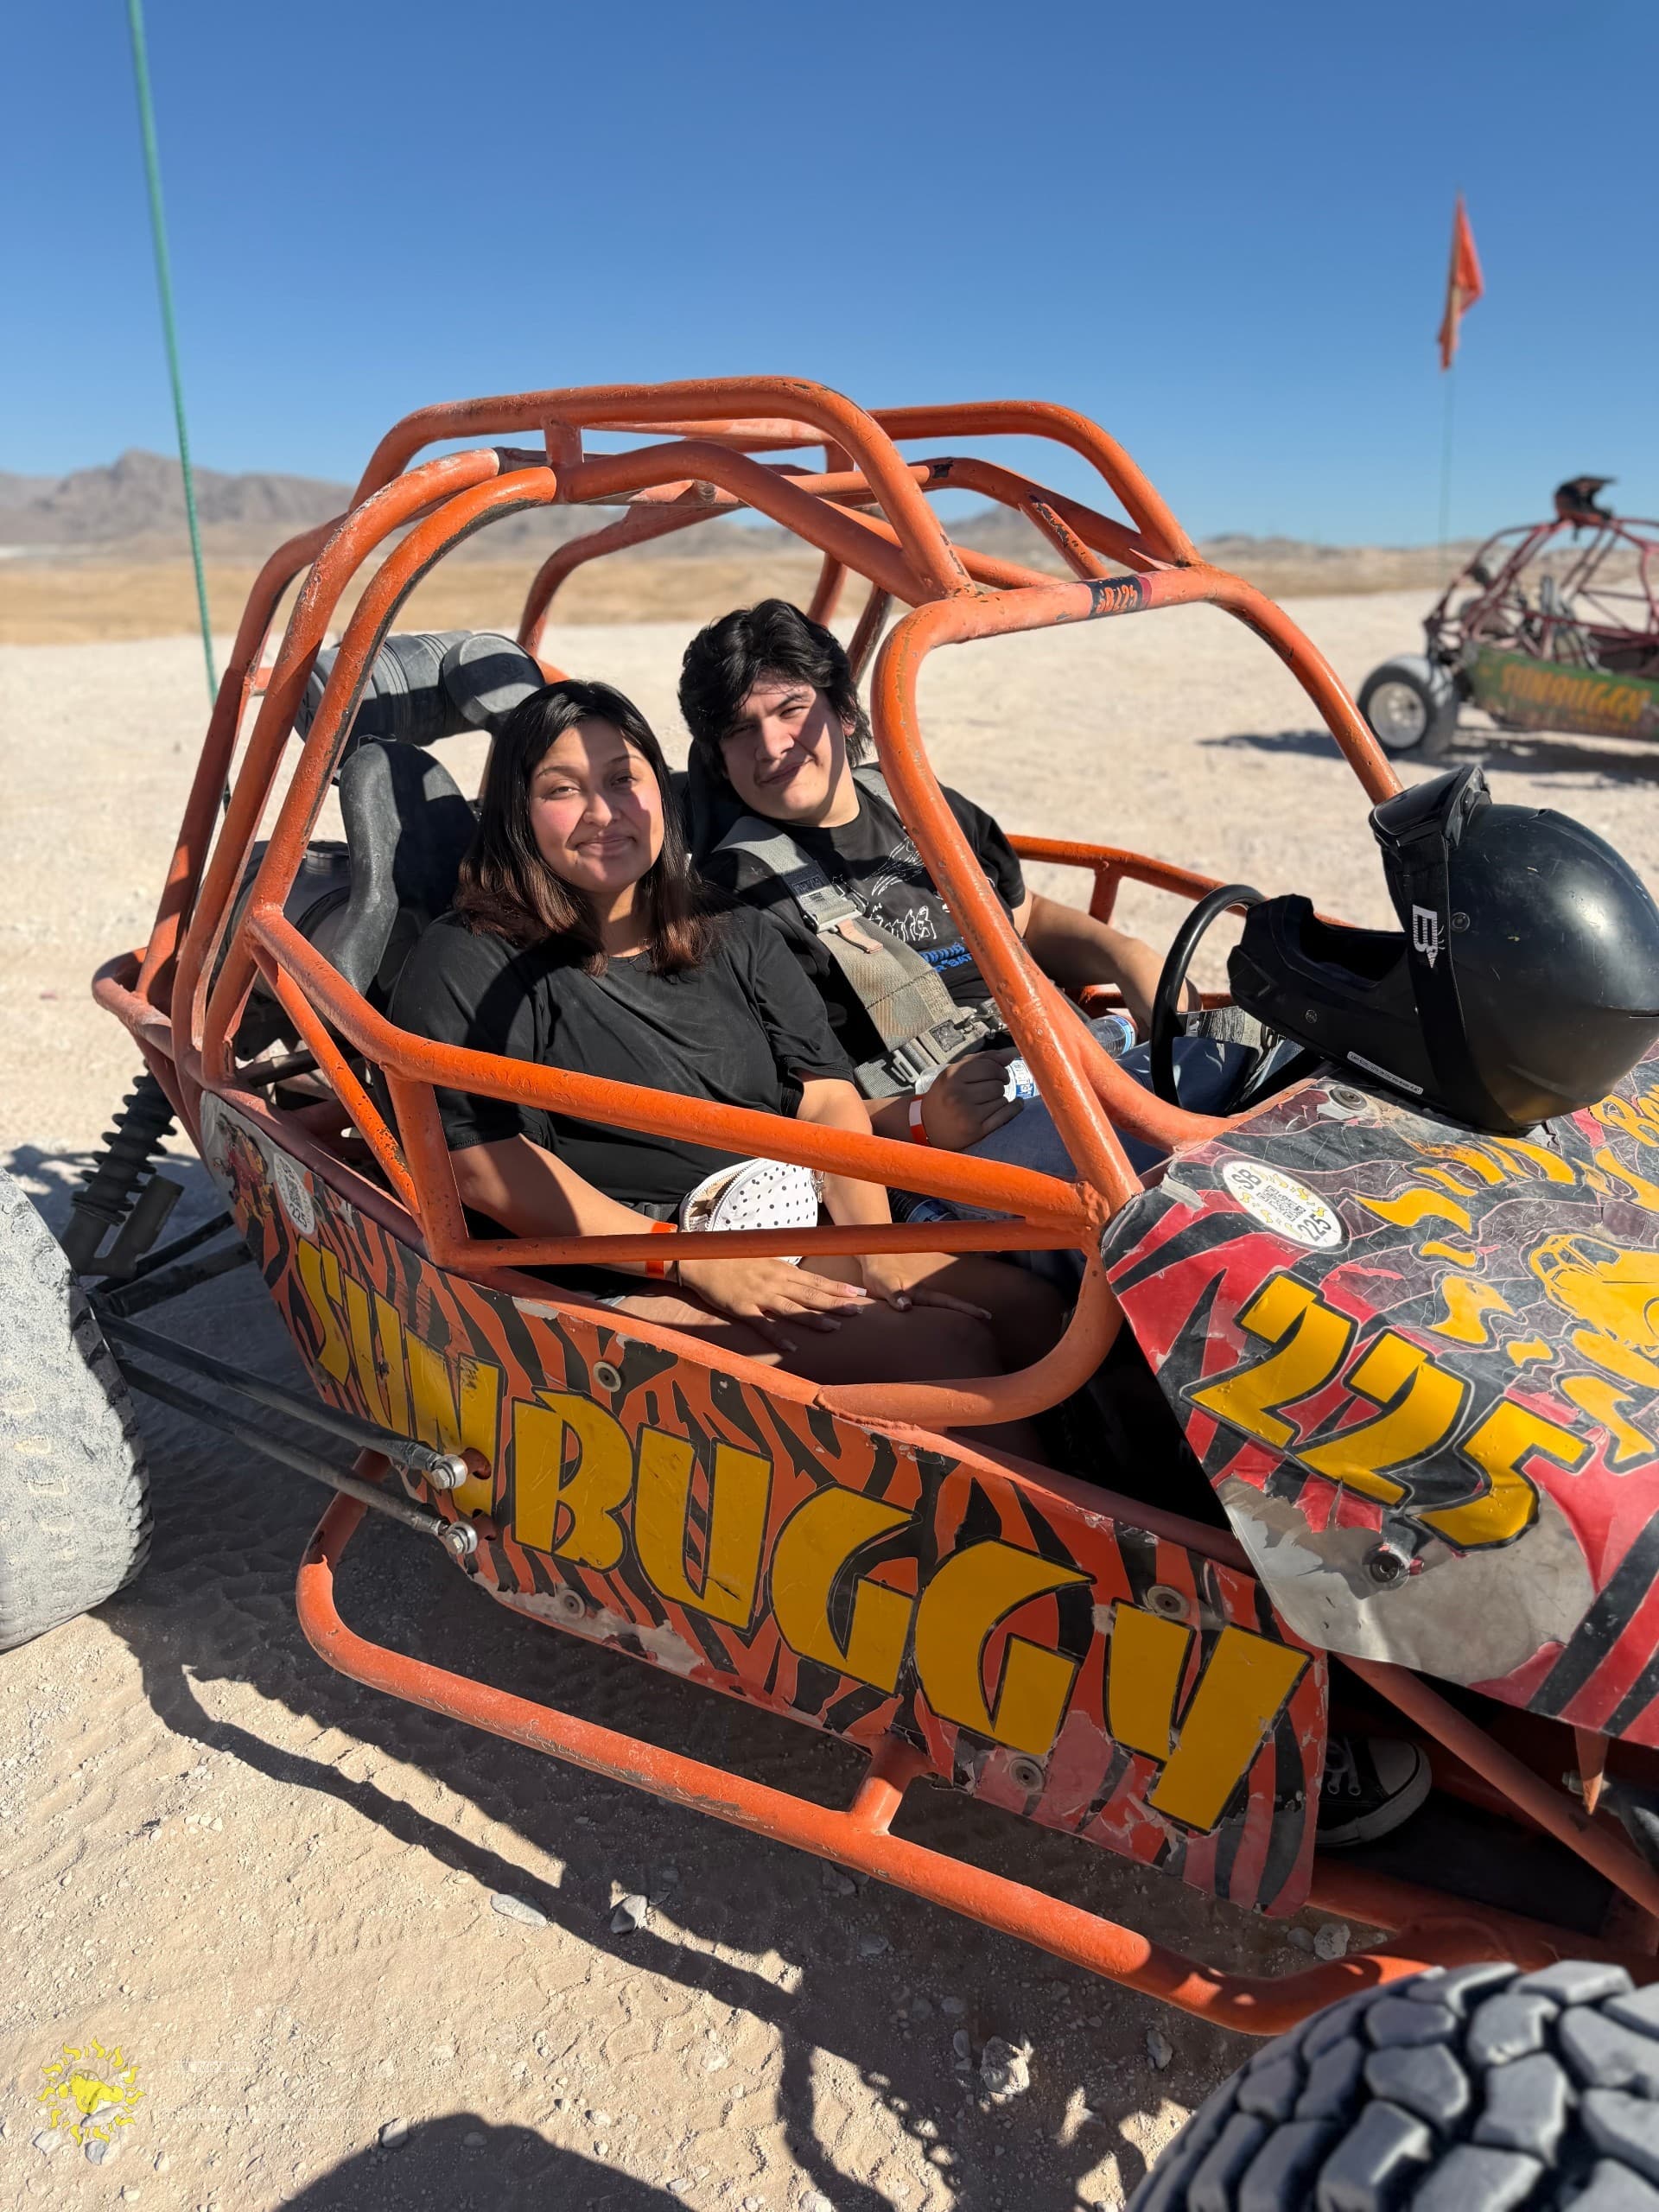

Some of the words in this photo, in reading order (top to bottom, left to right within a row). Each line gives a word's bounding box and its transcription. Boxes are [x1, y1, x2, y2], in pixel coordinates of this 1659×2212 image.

[1231, 1169, 1262, 1190] SB
[289, 1203, 307, 1228] 225
[1297, 1214, 1332, 1242] 225
[1183, 1271, 1592, 1548] 225
